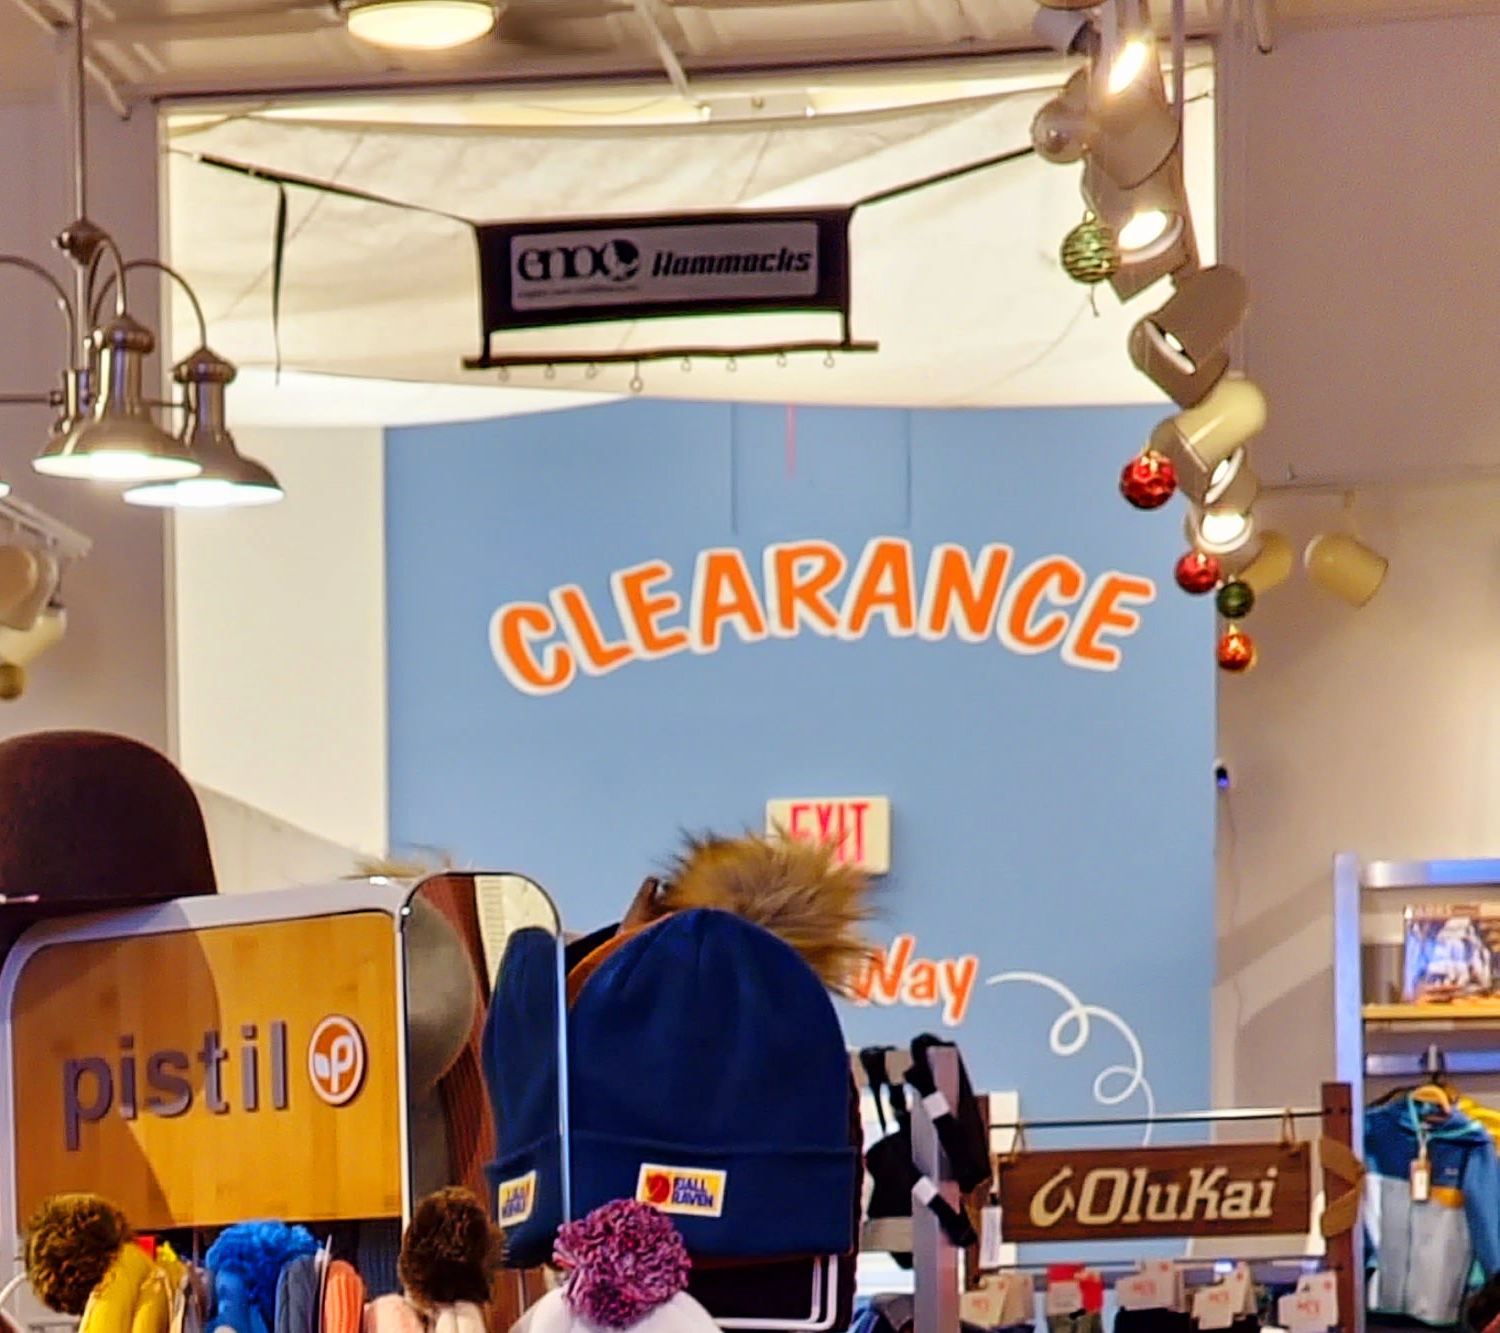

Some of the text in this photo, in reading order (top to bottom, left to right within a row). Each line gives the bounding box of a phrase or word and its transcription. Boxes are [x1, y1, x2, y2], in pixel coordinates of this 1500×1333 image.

[652, 247, 812, 278] Hammocks
[492, 538, 1155, 693] CLEARANCE
[790, 803, 869, 864] EXIT
[63, 1020, 289, 1151] pistil
[1076, 1165, 1279, 1226] OluKai
